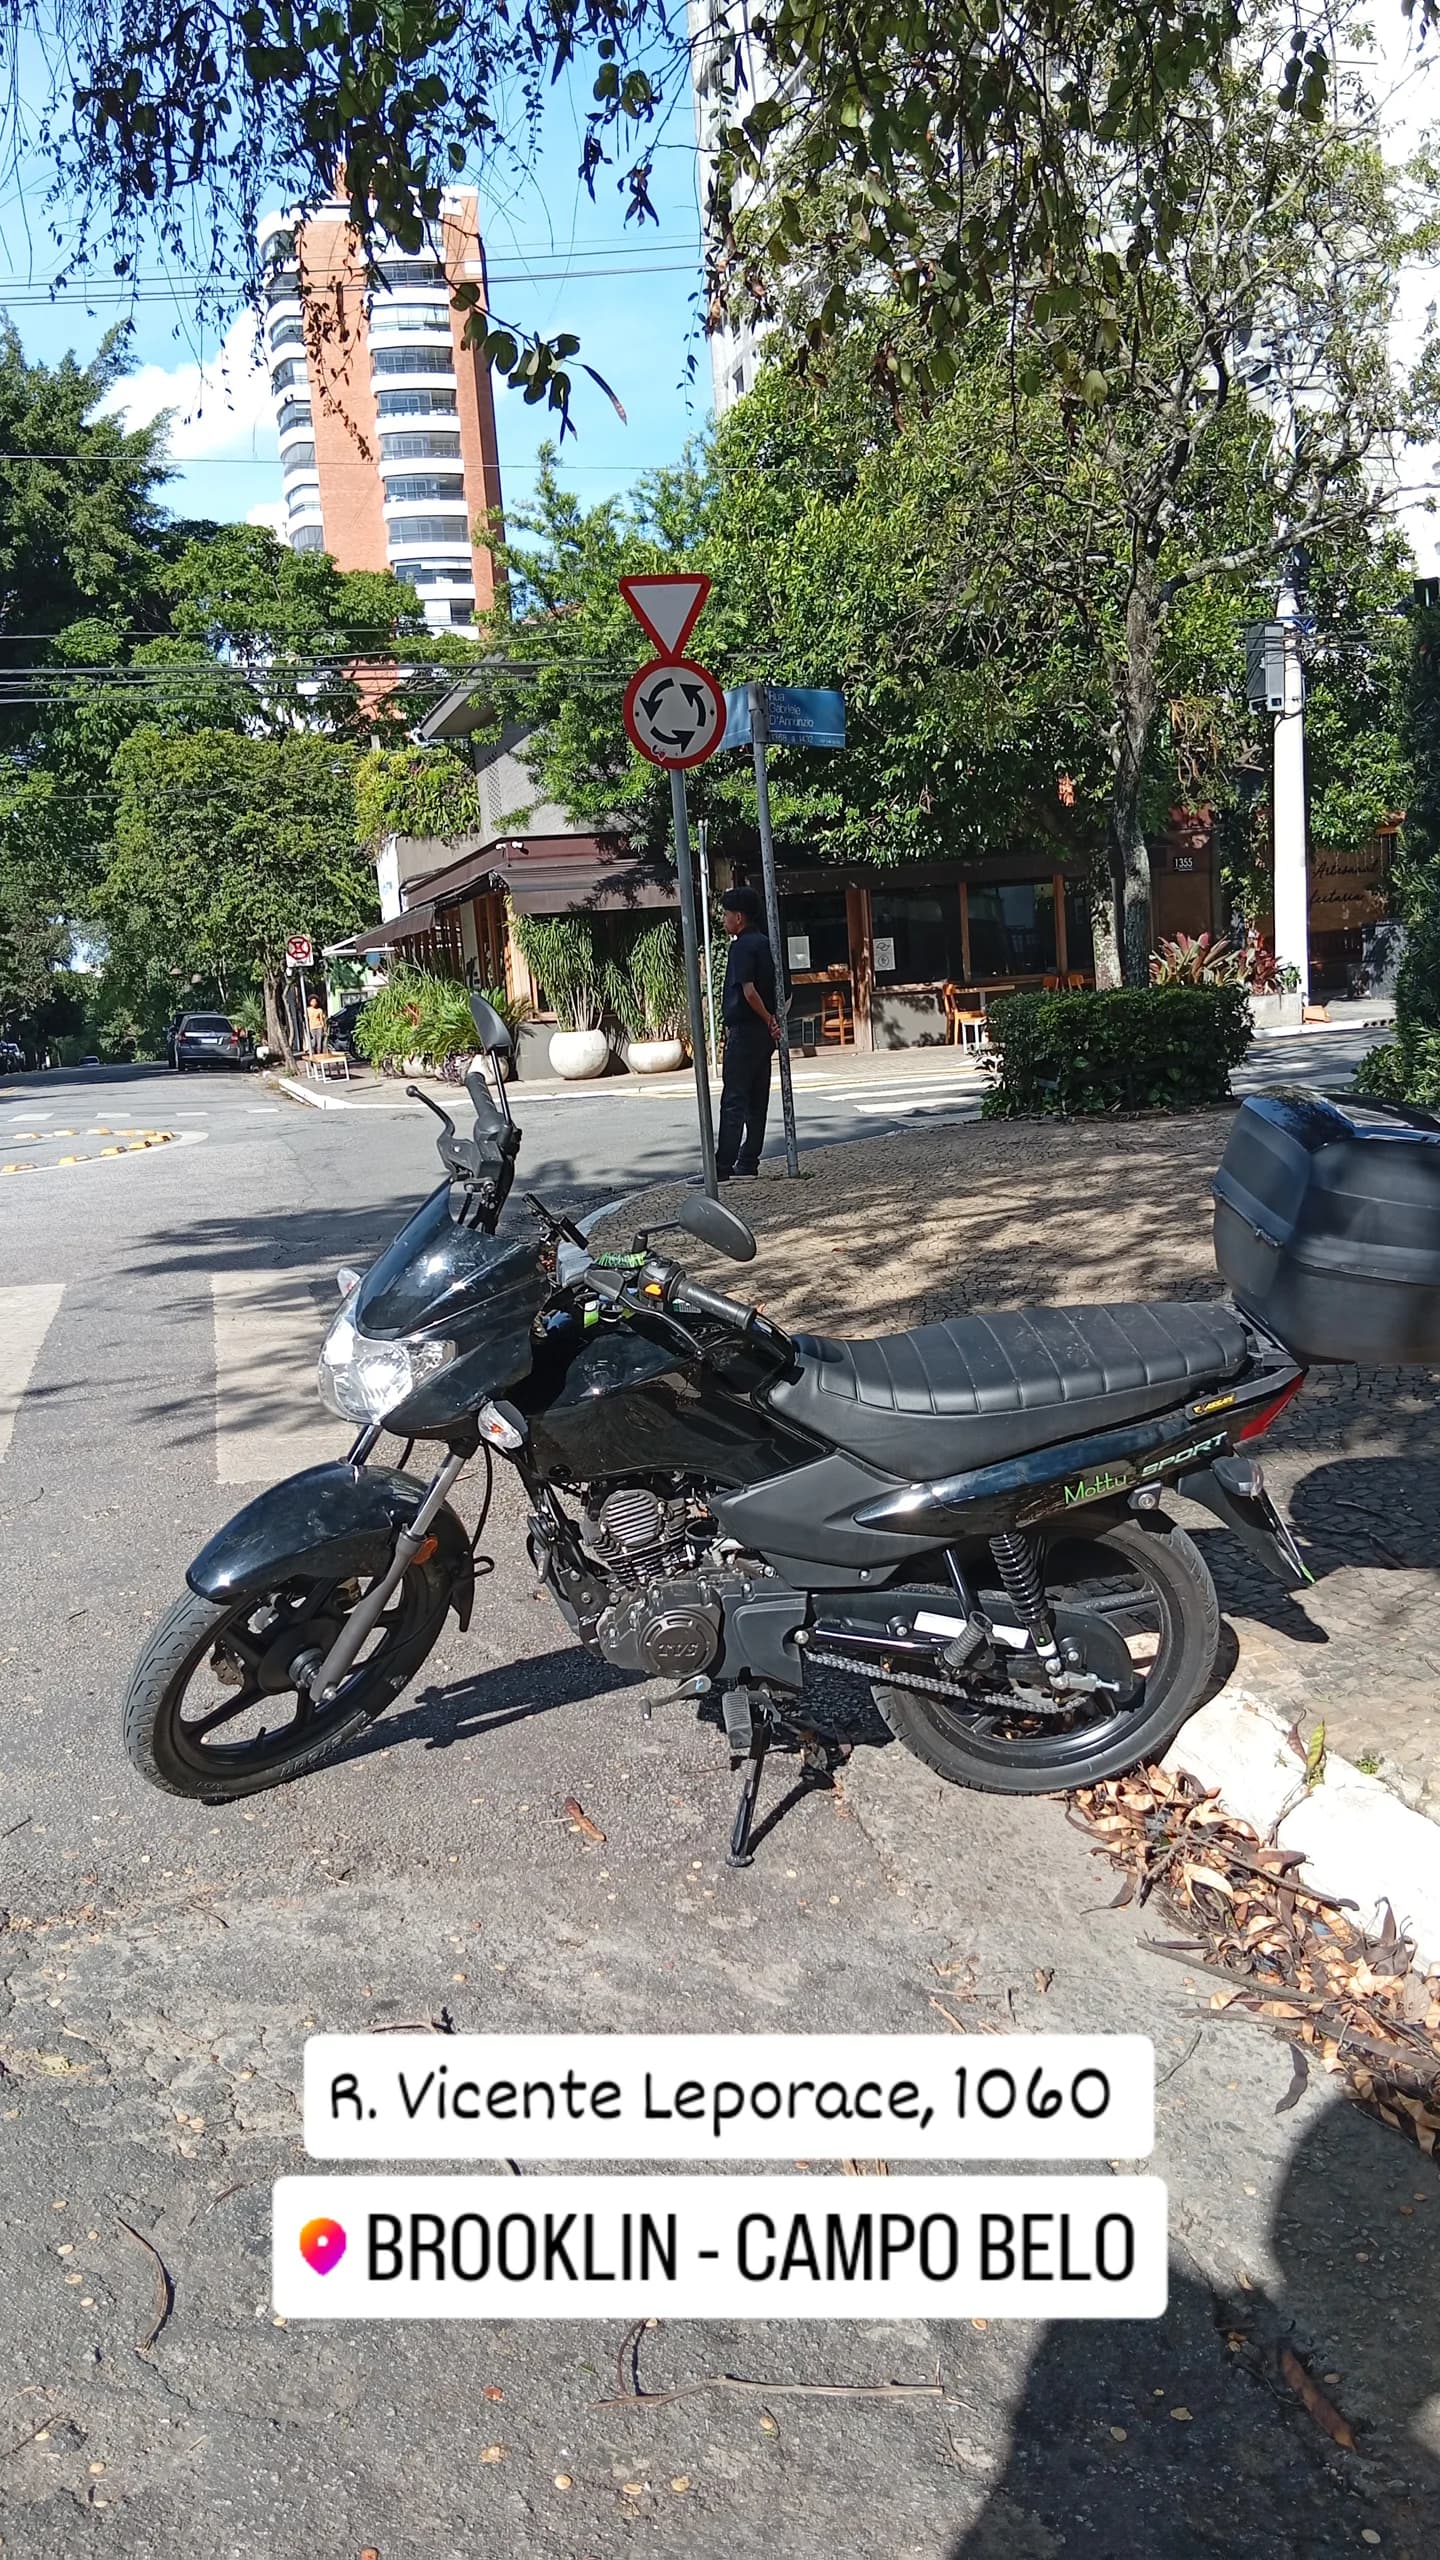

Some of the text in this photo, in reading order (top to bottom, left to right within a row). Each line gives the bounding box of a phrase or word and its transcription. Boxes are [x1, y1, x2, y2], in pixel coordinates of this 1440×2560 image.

[769, 690, 785, 702] Rua
[769, 702, 801, 715] Gabriele
[769, 715, 815, 728] D'Annunzio
[1175, 857, 1193, 868] 1355
[1064, 1431, 1228, 1505] Mottu SPORT
